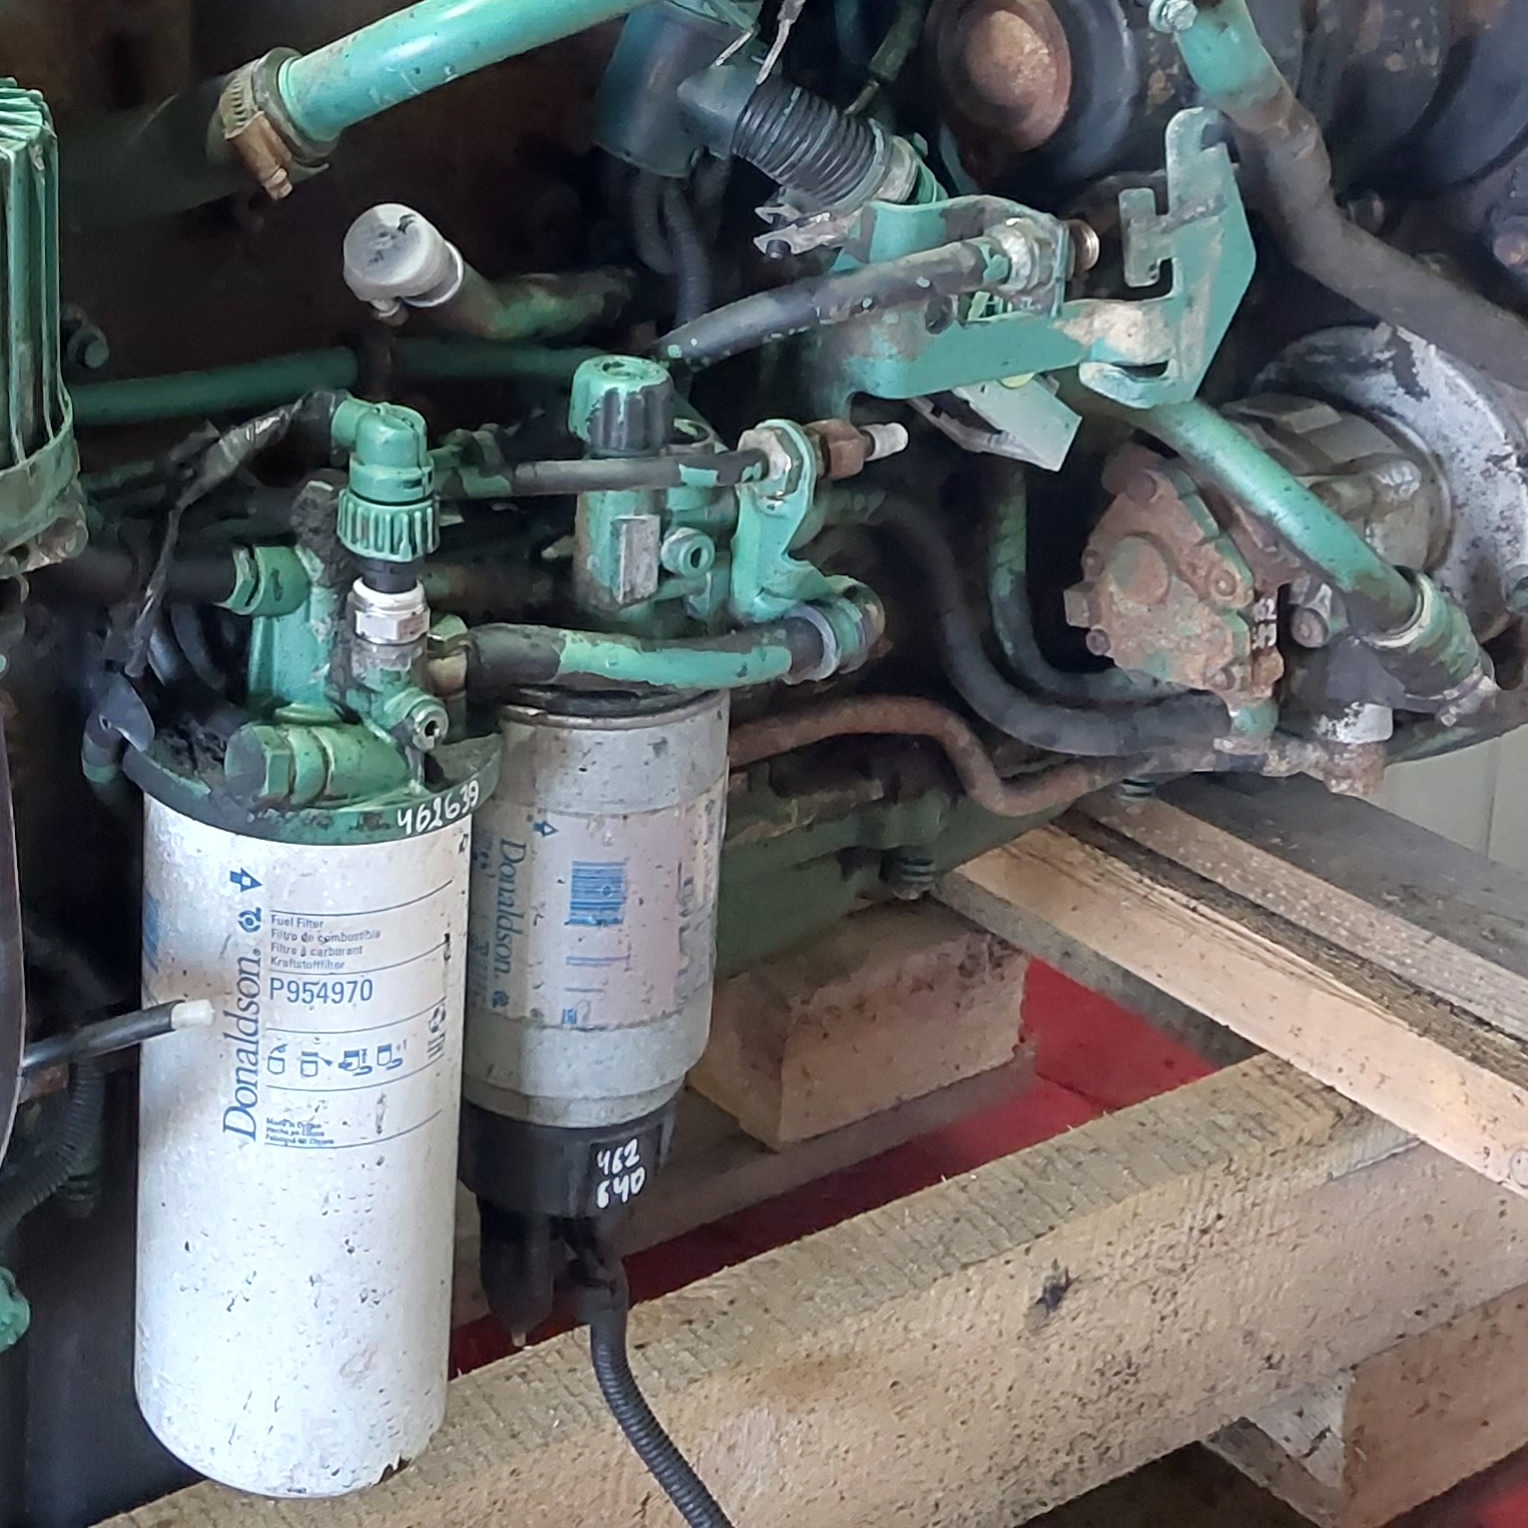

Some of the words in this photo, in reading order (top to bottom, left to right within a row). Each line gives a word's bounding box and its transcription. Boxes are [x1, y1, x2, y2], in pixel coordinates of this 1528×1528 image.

[397, 780, 479, 835] 462639
[271, 915, 294, 927] Fuel
[297, 917, 324, 929] Filter
[269, 977, 374, 1004] P954970
[597, 1138, 640, 1175] 462
[597, 1166, 645, 1209] 640
